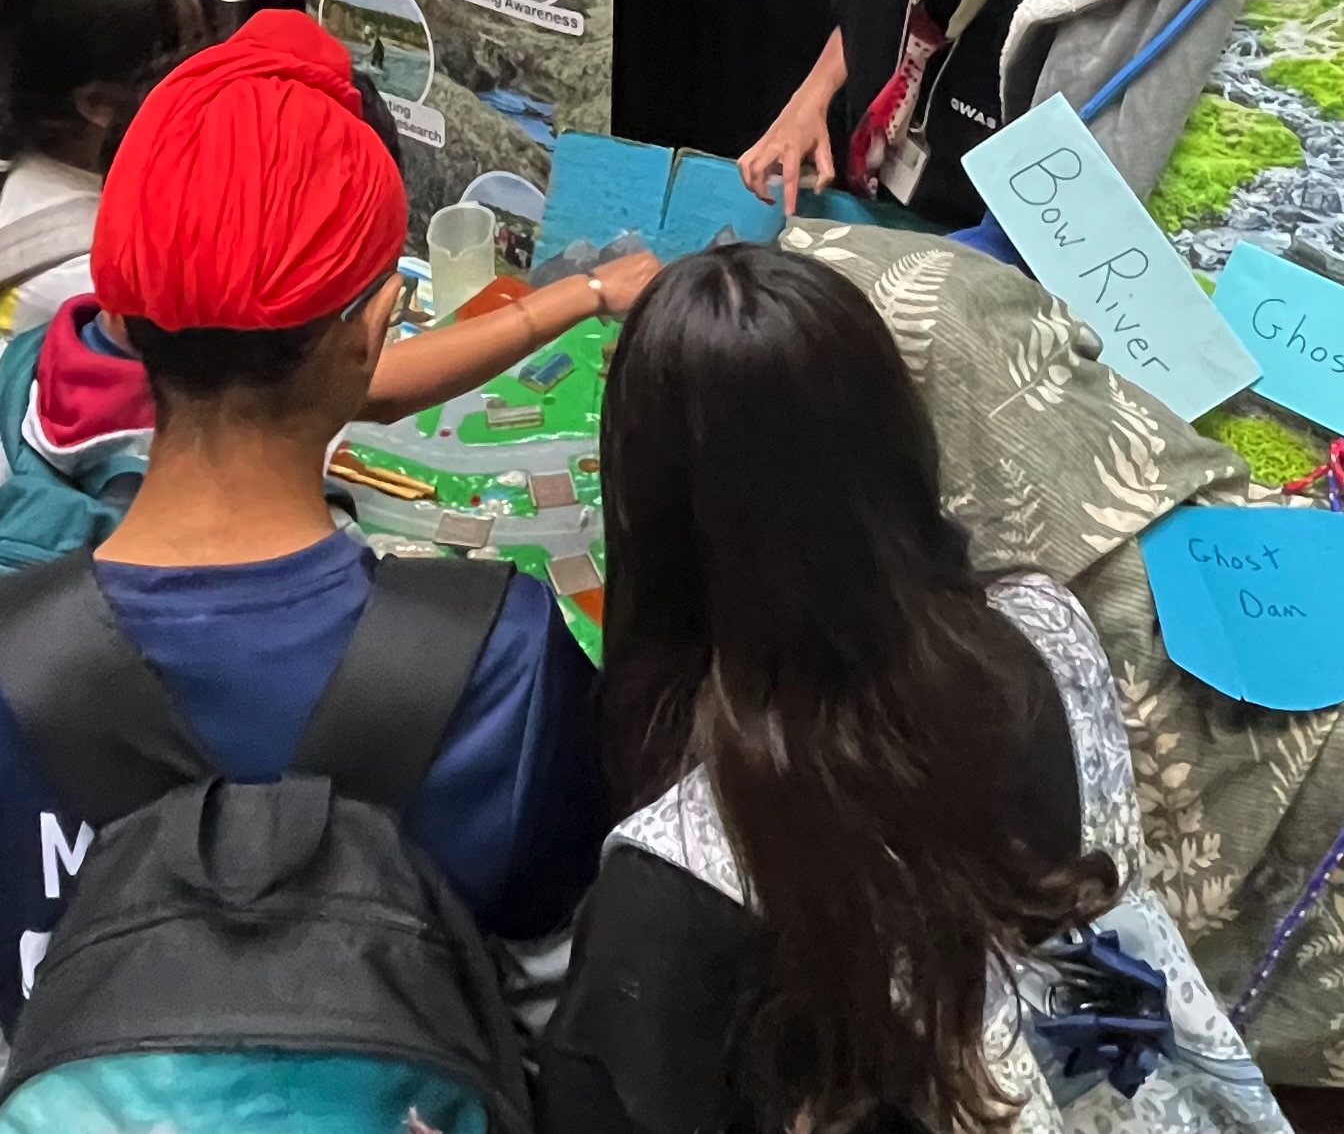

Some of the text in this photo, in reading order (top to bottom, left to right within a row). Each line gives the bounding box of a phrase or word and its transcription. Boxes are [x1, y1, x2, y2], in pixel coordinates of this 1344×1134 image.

[395, 120, 442, 144] esearch
[1008, 146, 1171, 373] Bow River
[1187, 537, 1280, 572] Ghost
